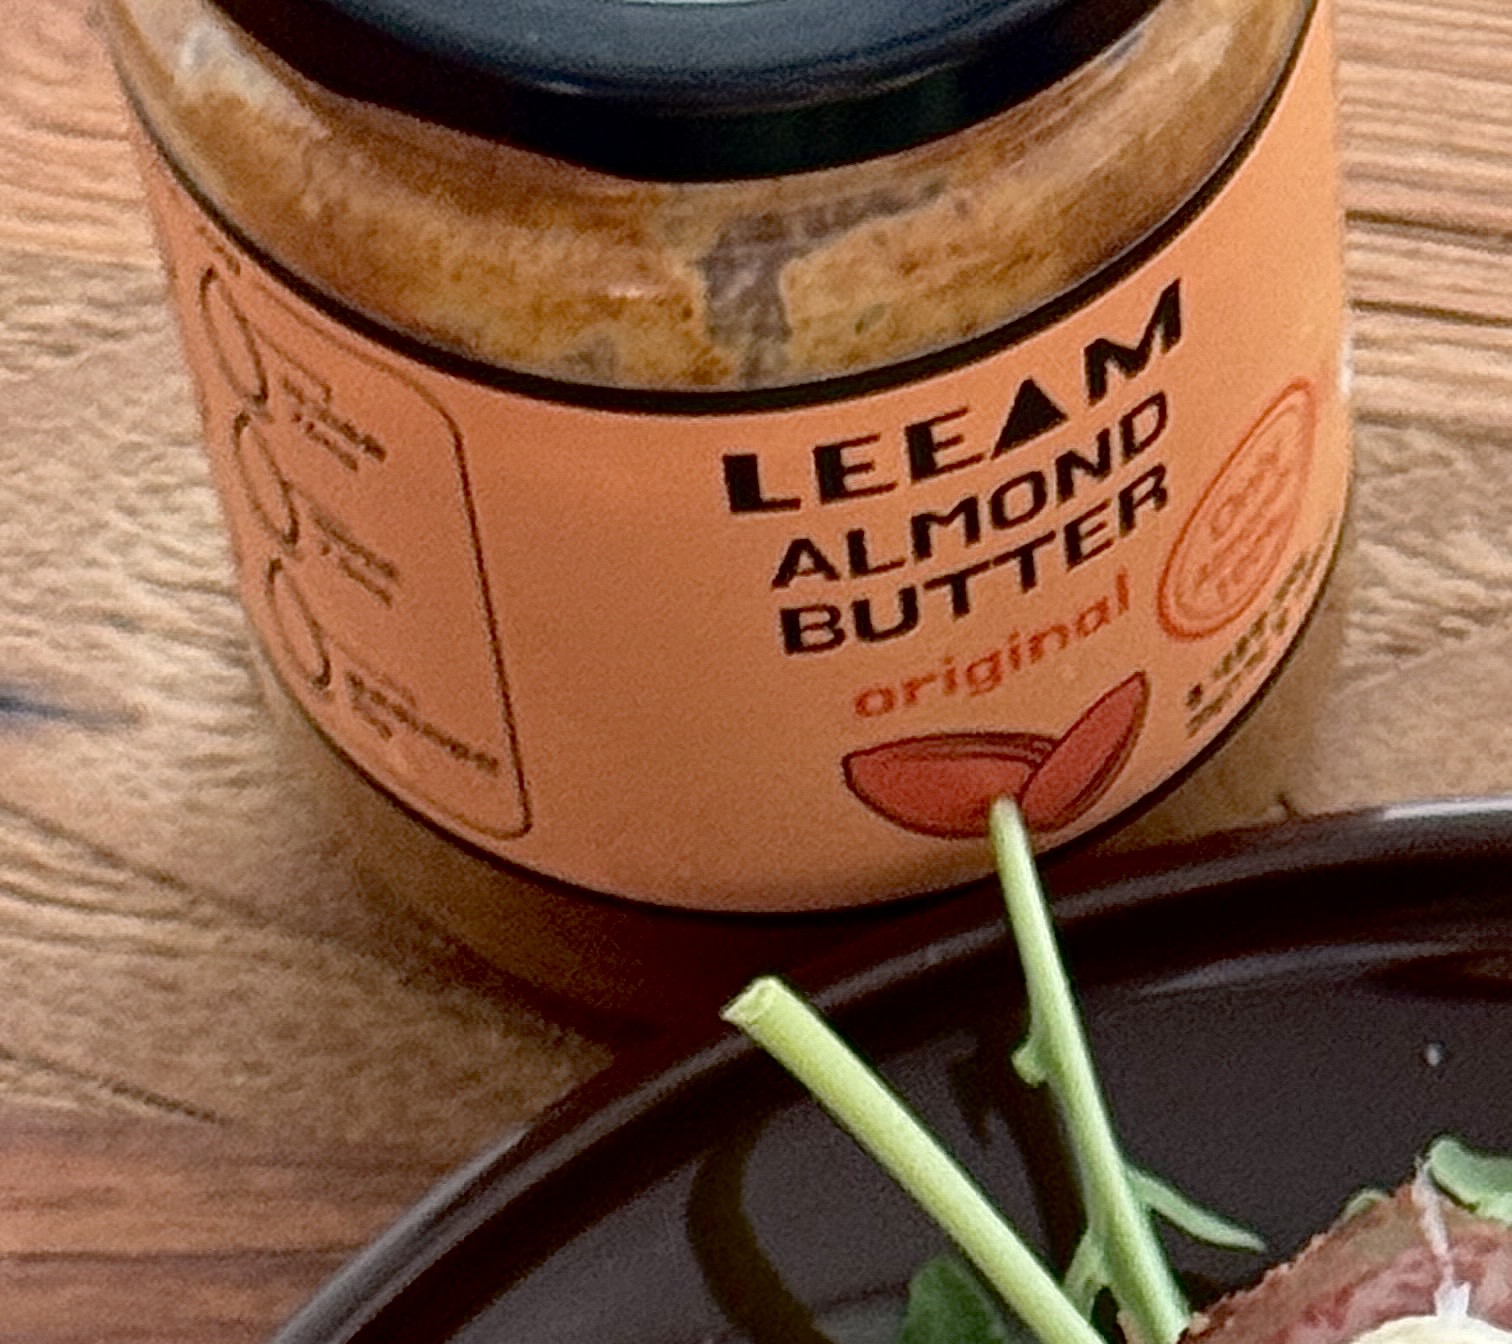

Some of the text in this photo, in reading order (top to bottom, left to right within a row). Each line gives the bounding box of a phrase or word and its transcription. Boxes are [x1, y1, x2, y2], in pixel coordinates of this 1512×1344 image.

[722, 277, 1183, 515] LEEAM
[771, 391, 1169, 590] ALMOND
[778, 463, 1170, 655] BUTTER
[854, 573, 1130, 718] original
